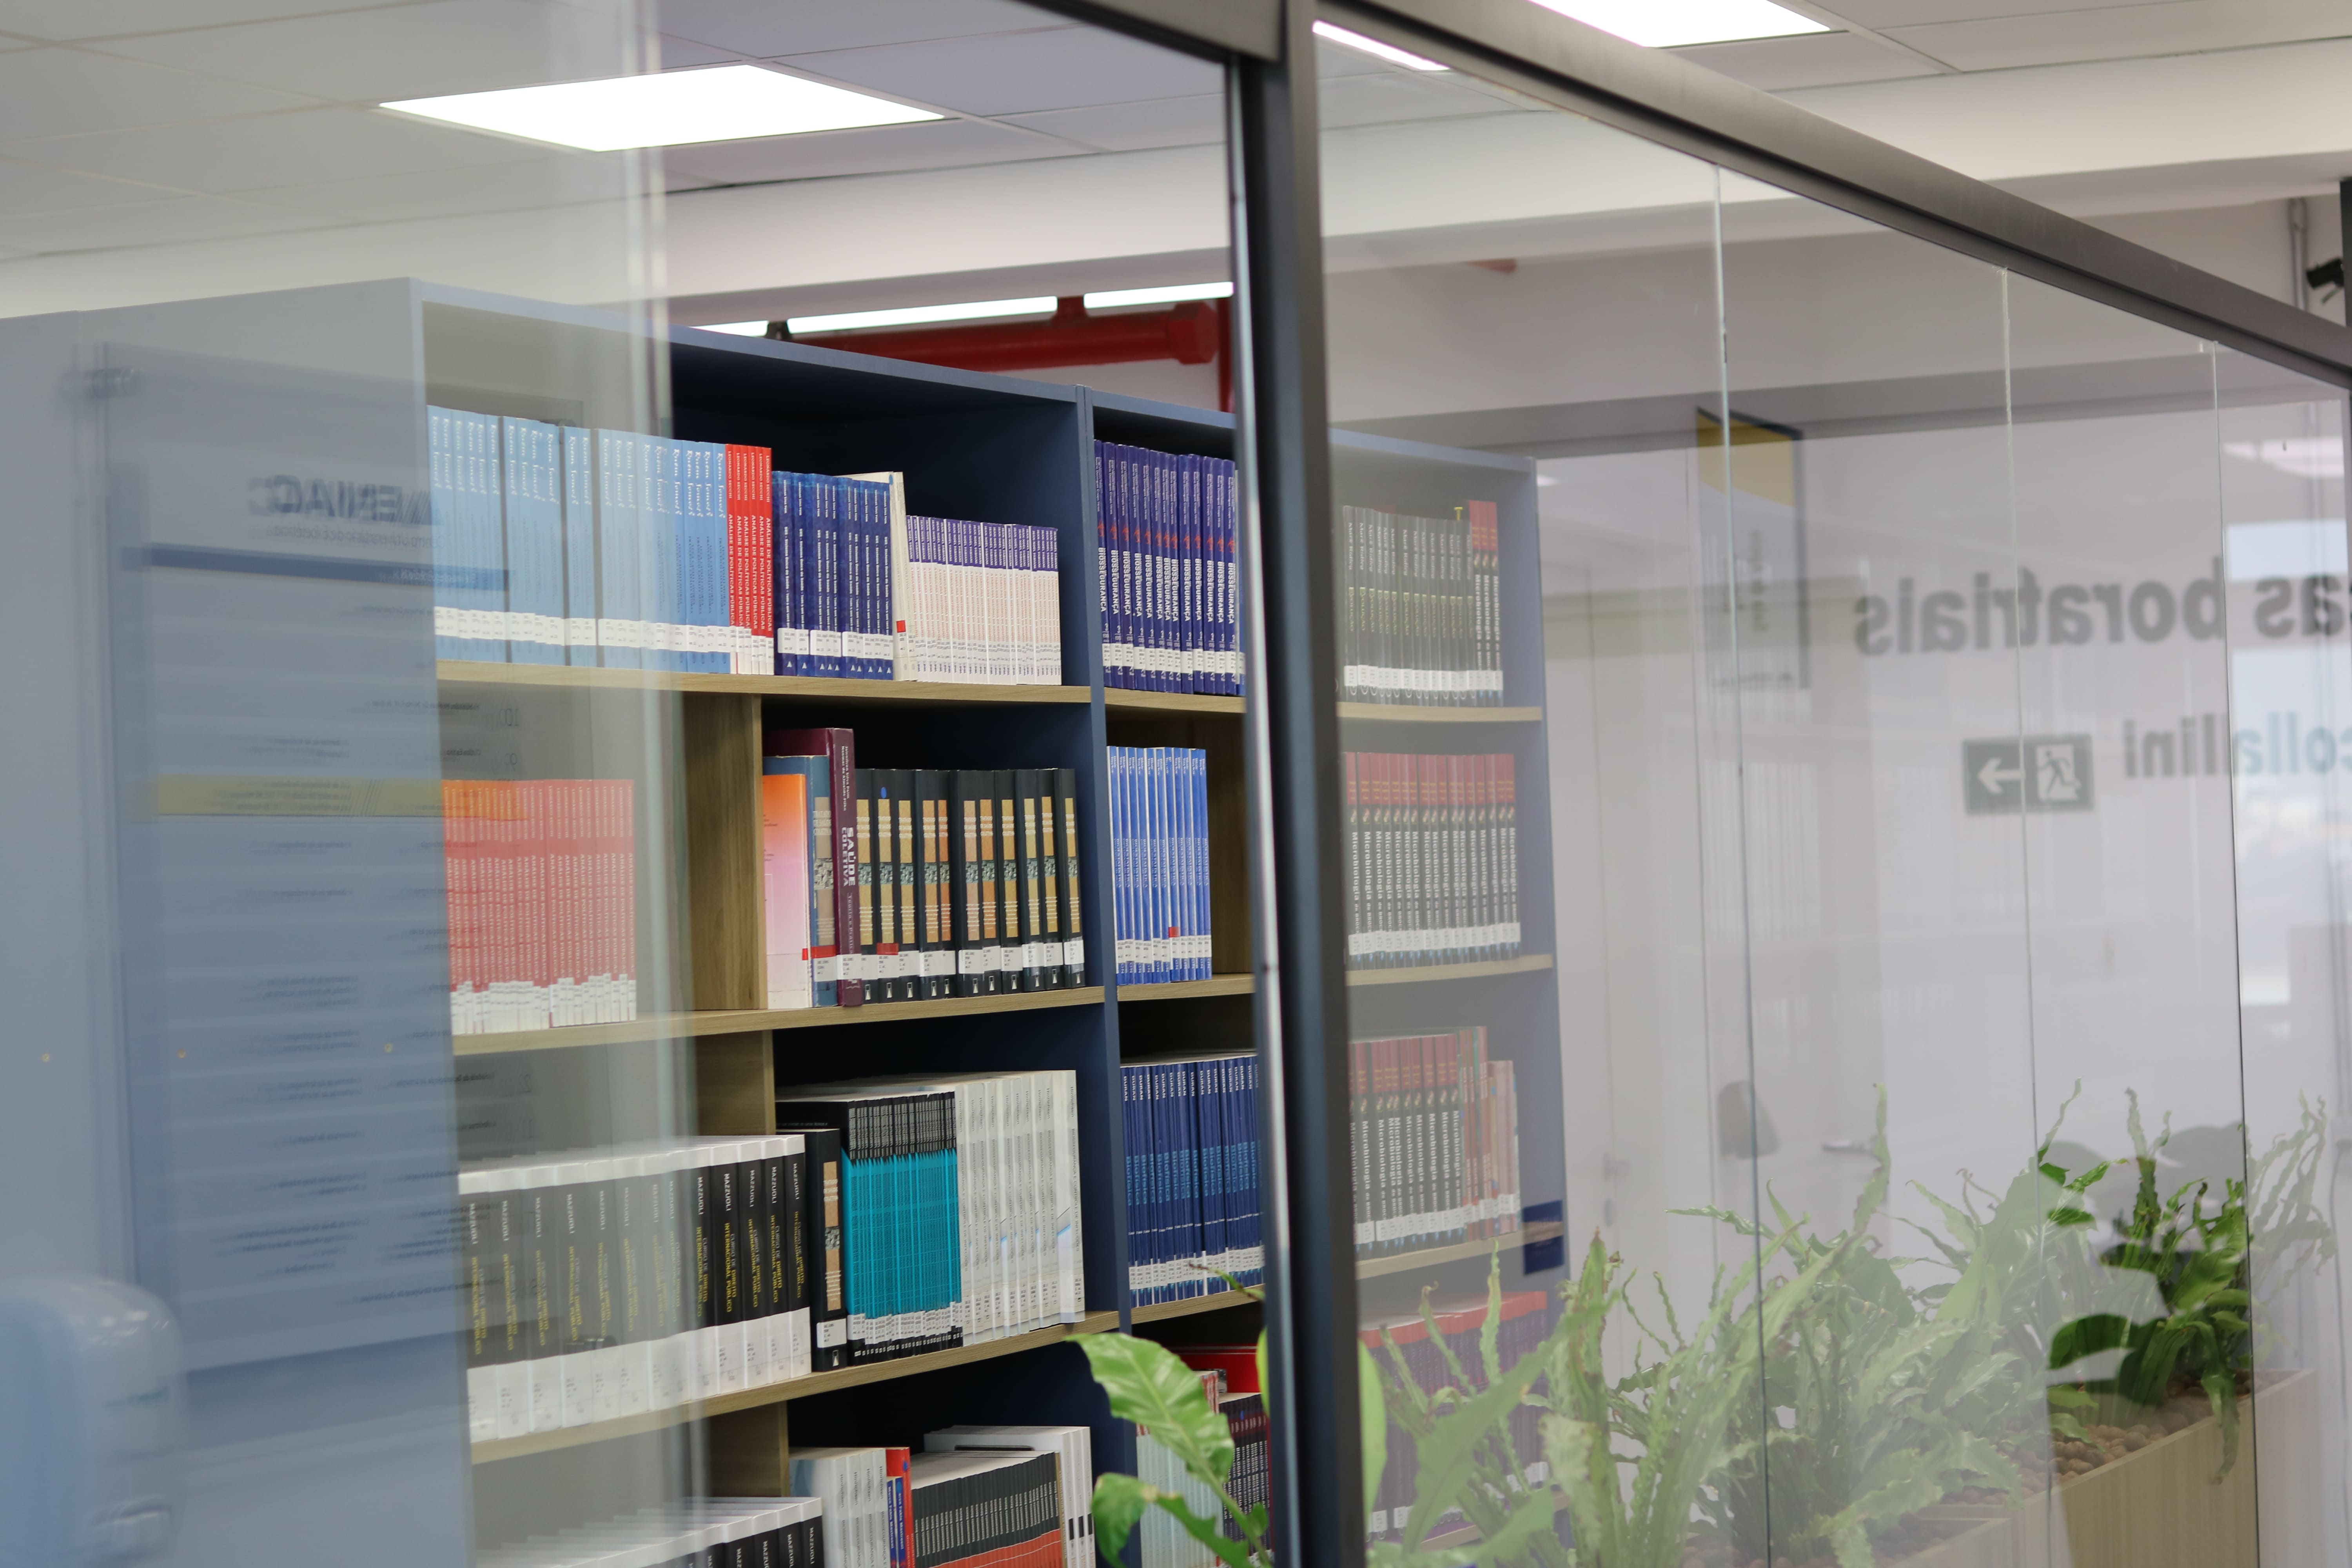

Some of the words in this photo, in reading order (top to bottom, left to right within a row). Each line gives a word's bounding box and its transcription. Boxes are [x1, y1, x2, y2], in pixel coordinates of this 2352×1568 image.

[752, 547, 757, 555] DE
[760, 548, 764, 556] DE
[767, 549, 771, 558] DE
[847, 828, 857, 886] SAÚDE
[1364, 831, 1372, 900] Microbiologia
[1362, 1121, 1371, 1189] Microbiologia
[1429, 1114, 1437, 1180] Microbiologia
[1442, 1112, 1450, 1178] Microbiologia
